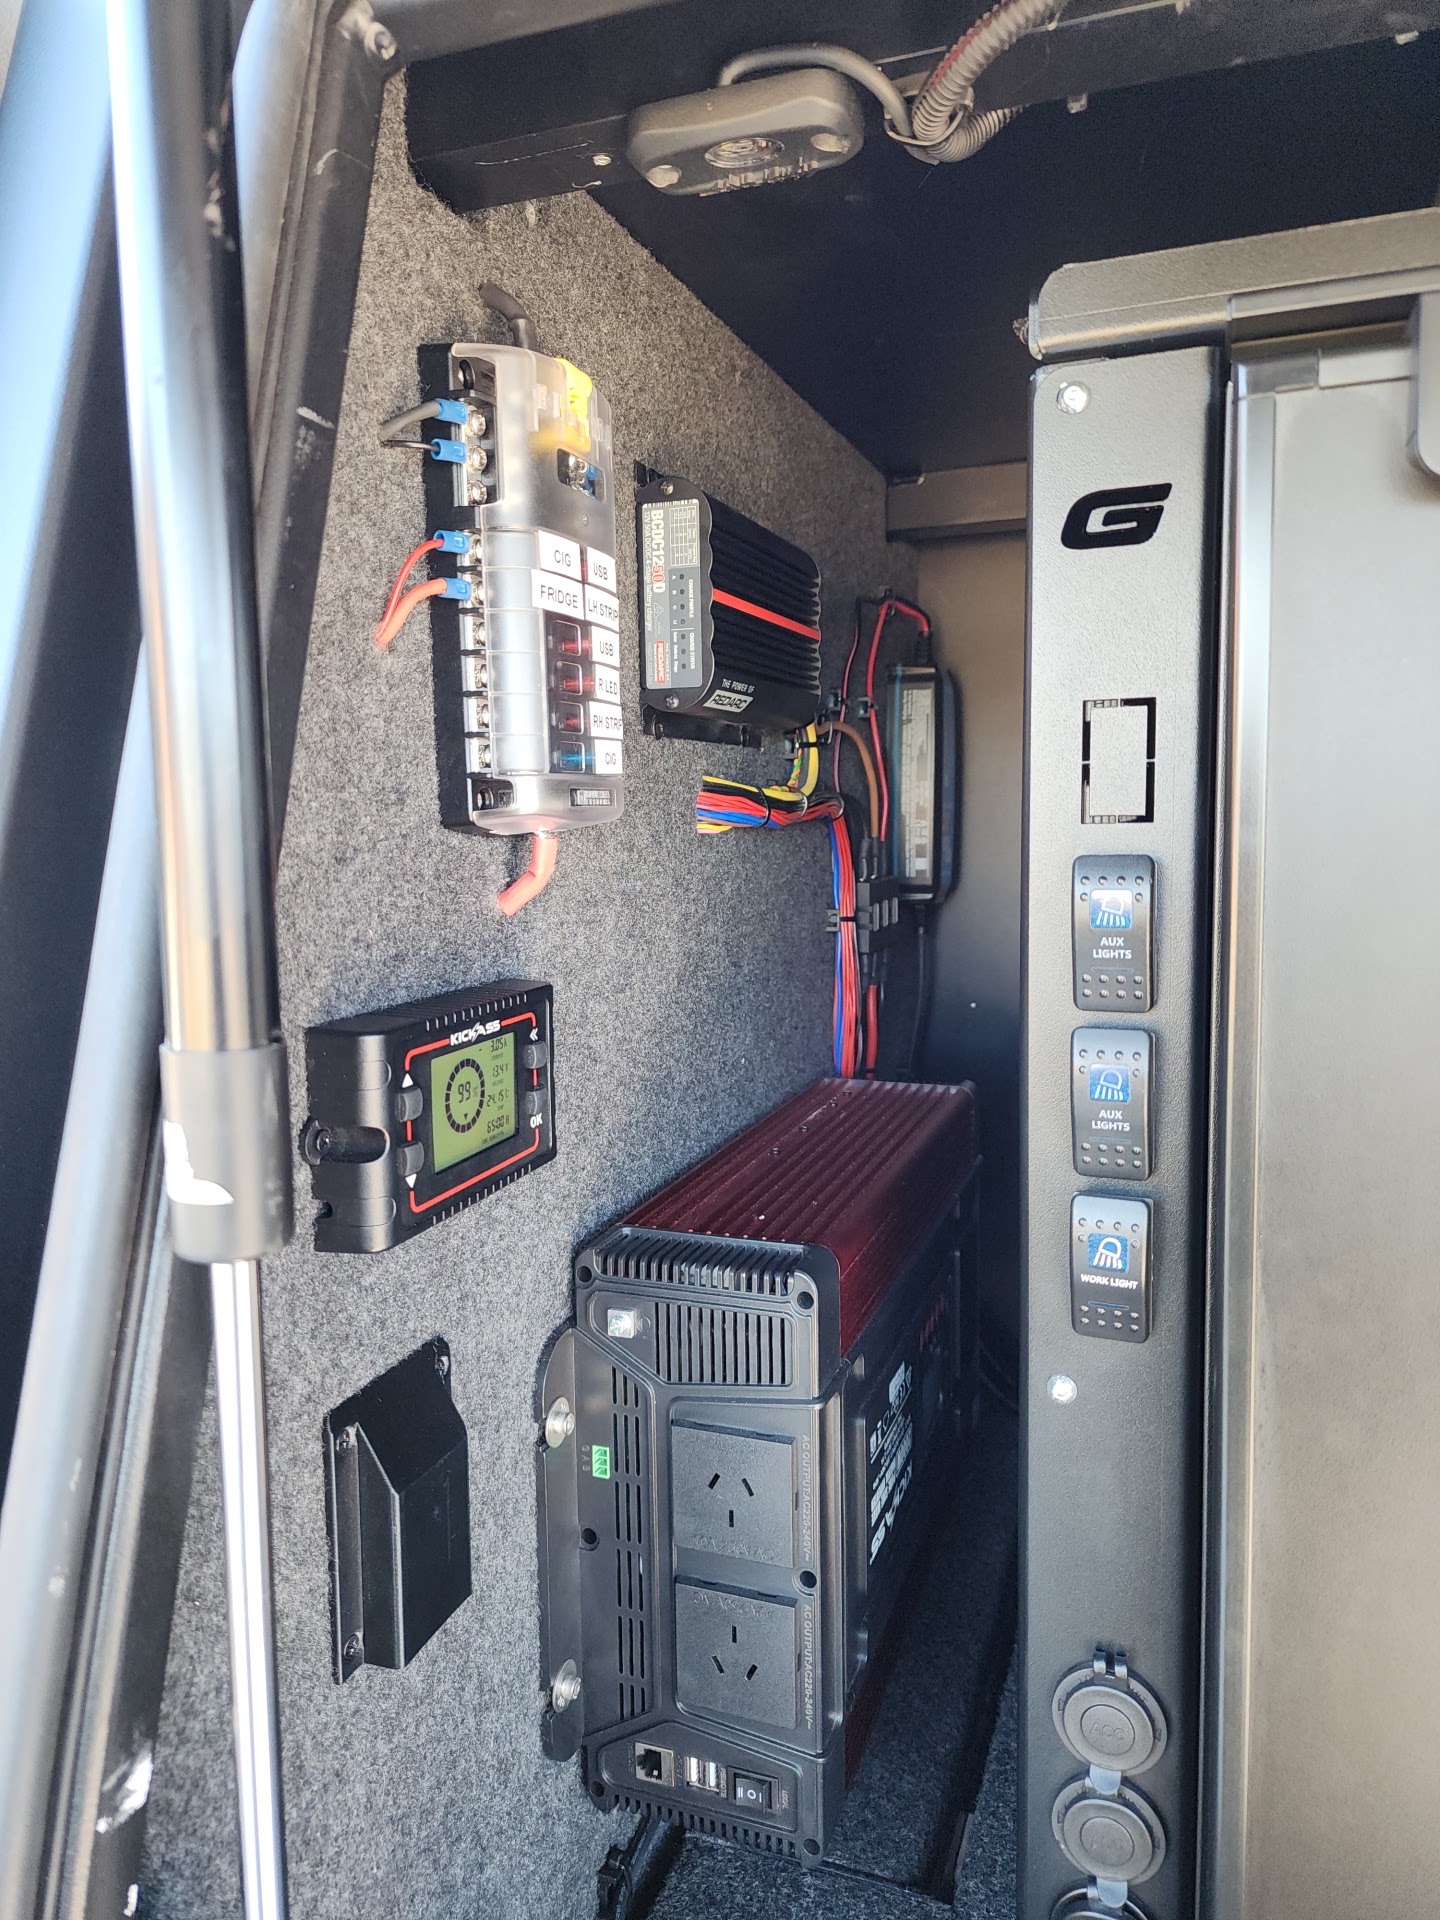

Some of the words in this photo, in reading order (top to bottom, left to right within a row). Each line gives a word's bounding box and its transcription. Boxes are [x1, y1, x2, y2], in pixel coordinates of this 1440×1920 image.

[554, 549, 572, 567] CIG
[651, 509, 666, 593] BCDC1250D
[593, 562, 608, 580] USB
[540, 584, 579, 609] FRIDGE
[645, 584, 653, 607] battery
[588, 598, 598, 613] LH
[600, 603, 619, 622] STRIP
[645, 607, 653, 631] charger
[599, 641, 614, 657] USB
[598, 678, 604, 690] R
[605, 680, 618, 694] LED
[731, 681, 748, 692] POWER
[709, 693, 748, 709] REDARC
[593, 715, 603, 728] RH
[605, 717, 623, 732] STRIP
[605, 752, 617, 765] CIG
[1100, 936, 1125, 947] AUX
[1092, 948, 1132, 960] LIGHTS
[450, 1019, 500, 1046] KICKASS
[457, 1080, 471, 1103] 99
[530, 1112, 543, 1129] OK
[1098, 1109, 1123, 1120] AUX
[1091, 1120, 1131, 1132] LIGHTS
[1080, 1273, 1109, 1286] WORK
[1109, 1277, 1139, 1290] LIGHT
[802, 1434, 810, 1450] AC
[803, 1604, 812, 1619] AC
